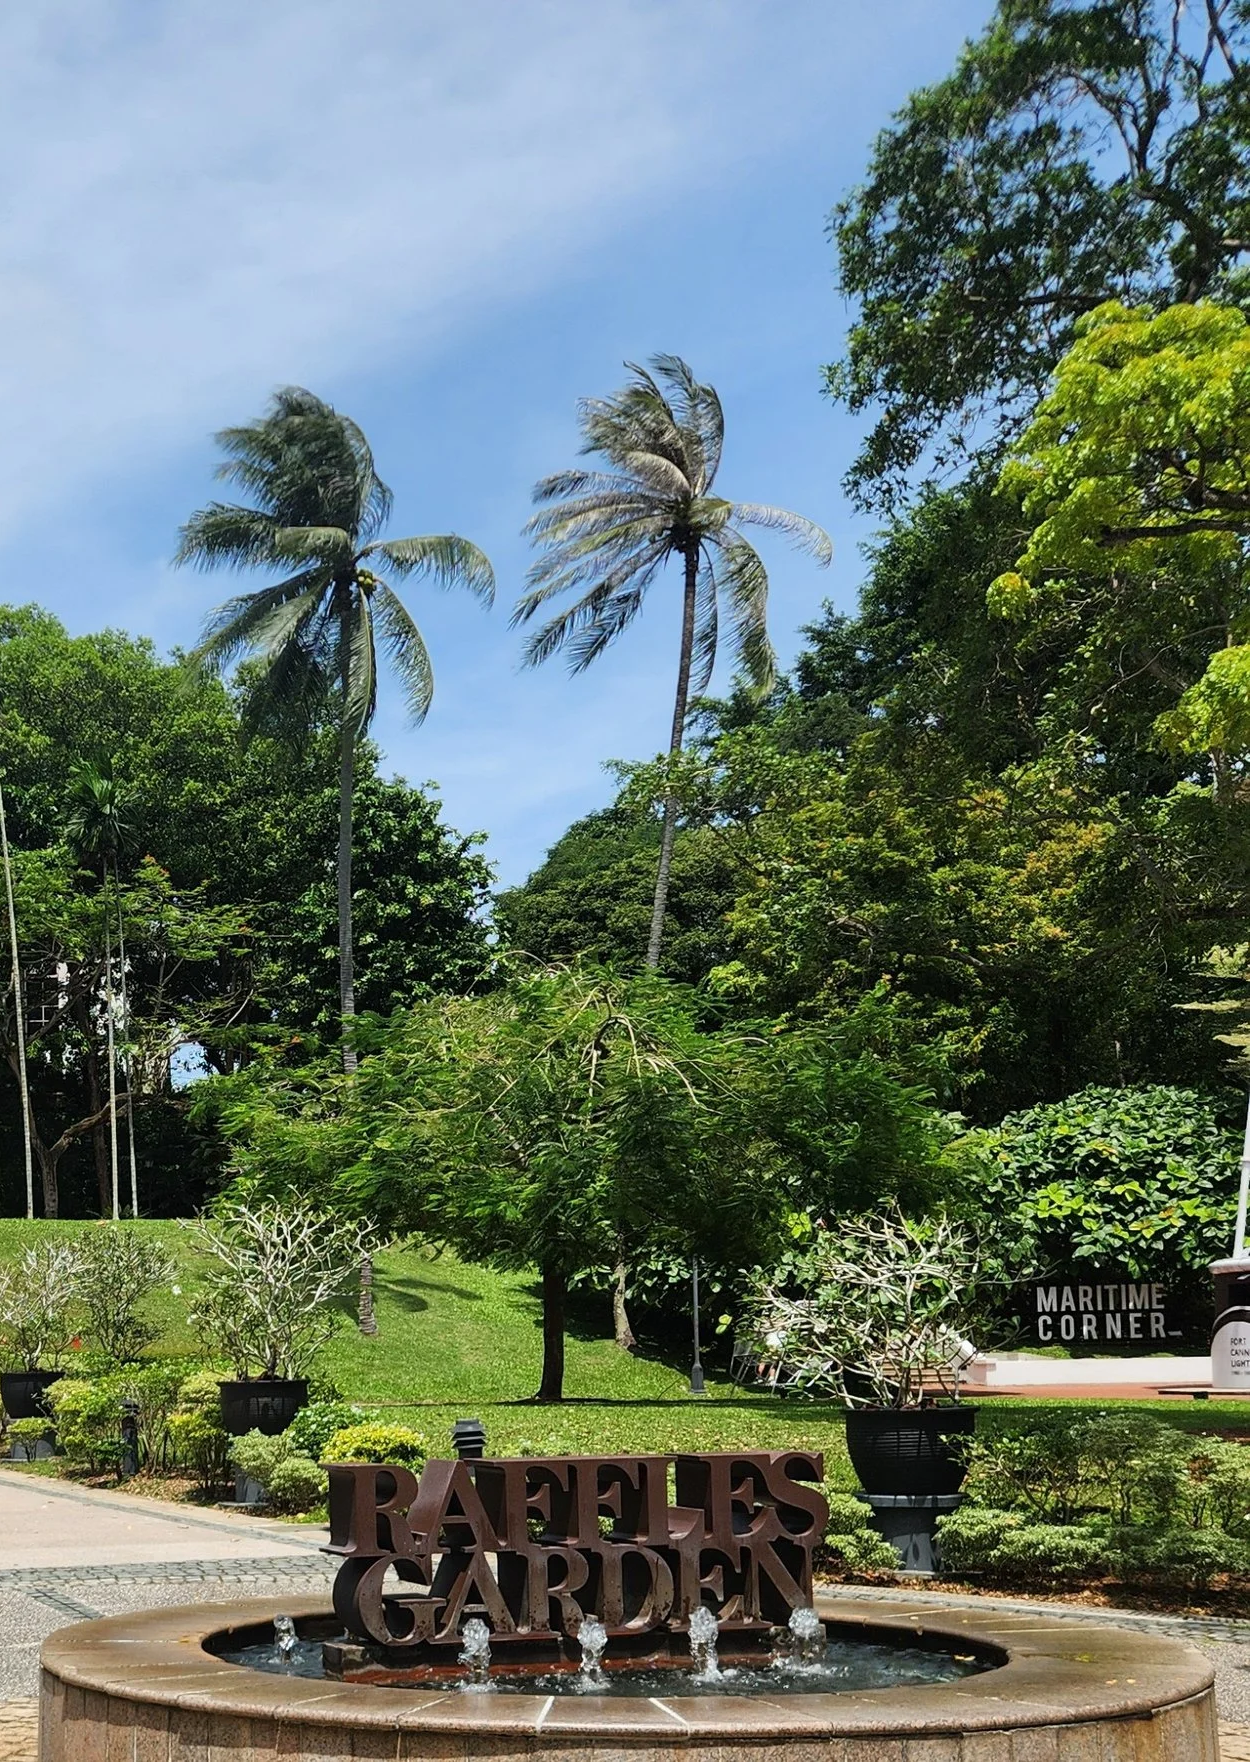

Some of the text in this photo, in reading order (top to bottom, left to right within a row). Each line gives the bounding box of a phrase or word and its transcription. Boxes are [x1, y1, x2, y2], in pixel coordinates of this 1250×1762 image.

[1036, 1283, 1166, 1312] MARITIME
[319, 1451, 829, 1557] RAFFLES
[333, 1540, 816, 1646] GARDEN
